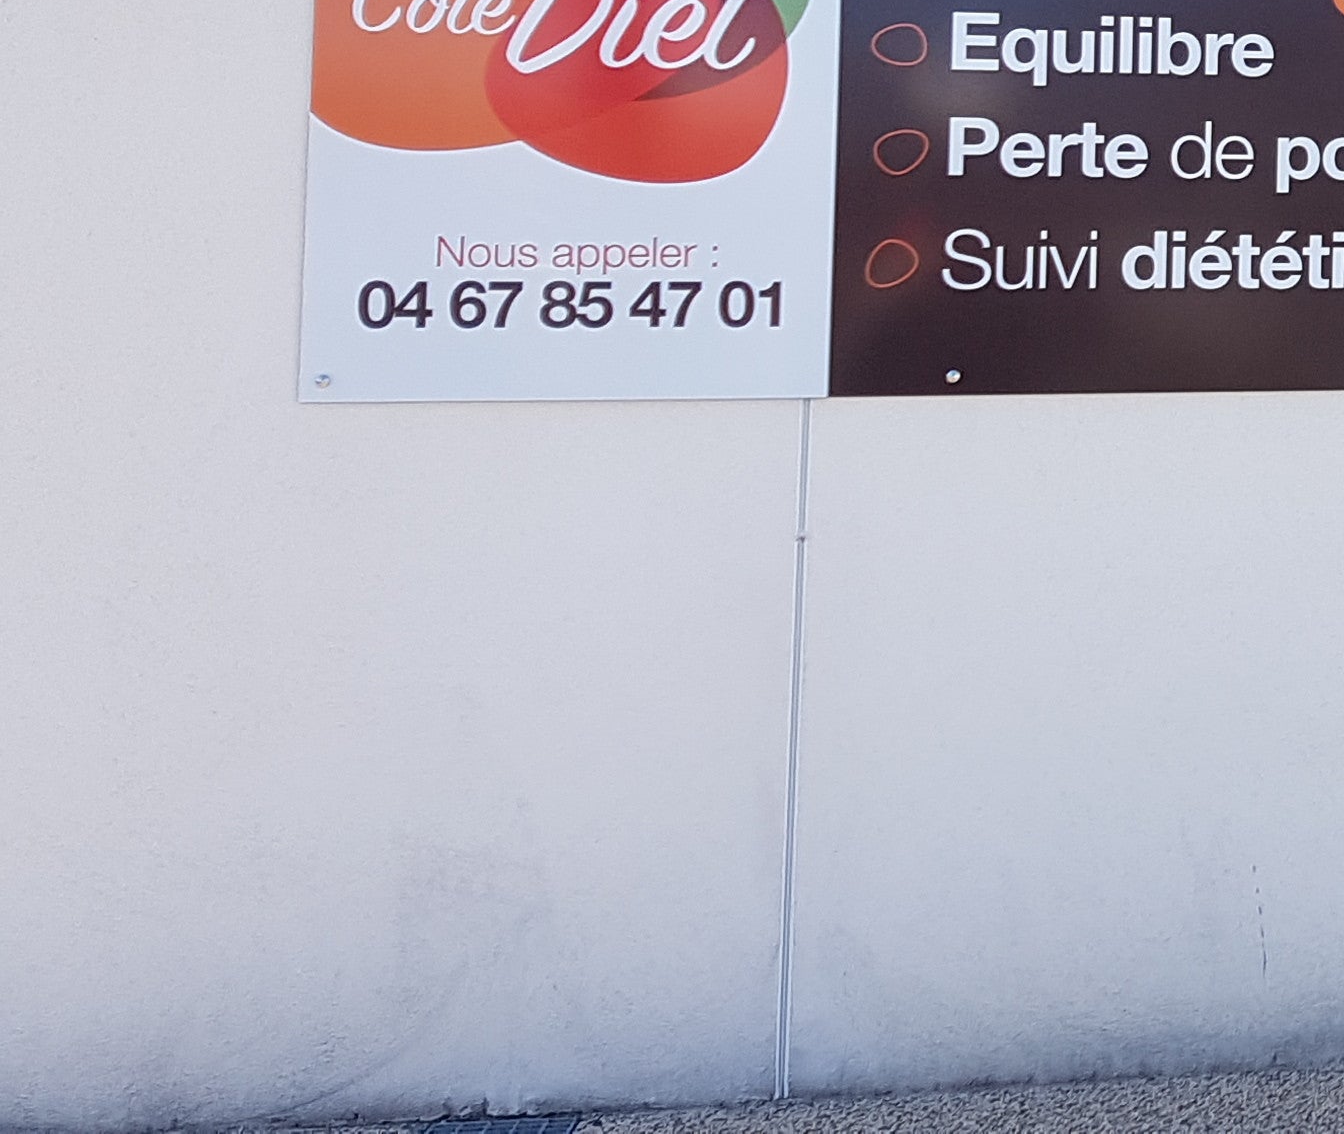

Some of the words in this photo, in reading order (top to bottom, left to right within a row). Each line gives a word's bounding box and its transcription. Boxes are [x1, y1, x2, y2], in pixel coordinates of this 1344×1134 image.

[950, 11, 1275, 86] Equilibre
[946, 115, 1149, 179] Perte
[1169, 121, 1255, 180] de
[435, 235, 537, 269] Nous
[552, 237, 698, 276] appeler
[941, 228, 1099, 290] Suivi
[357, 280, 433, 330] 04
[449, 280, 524, 330] 67
[540, 280, 615, 330] 85
[629, 280, 702, 330] 47
[718, 280, 783, 330] 01
